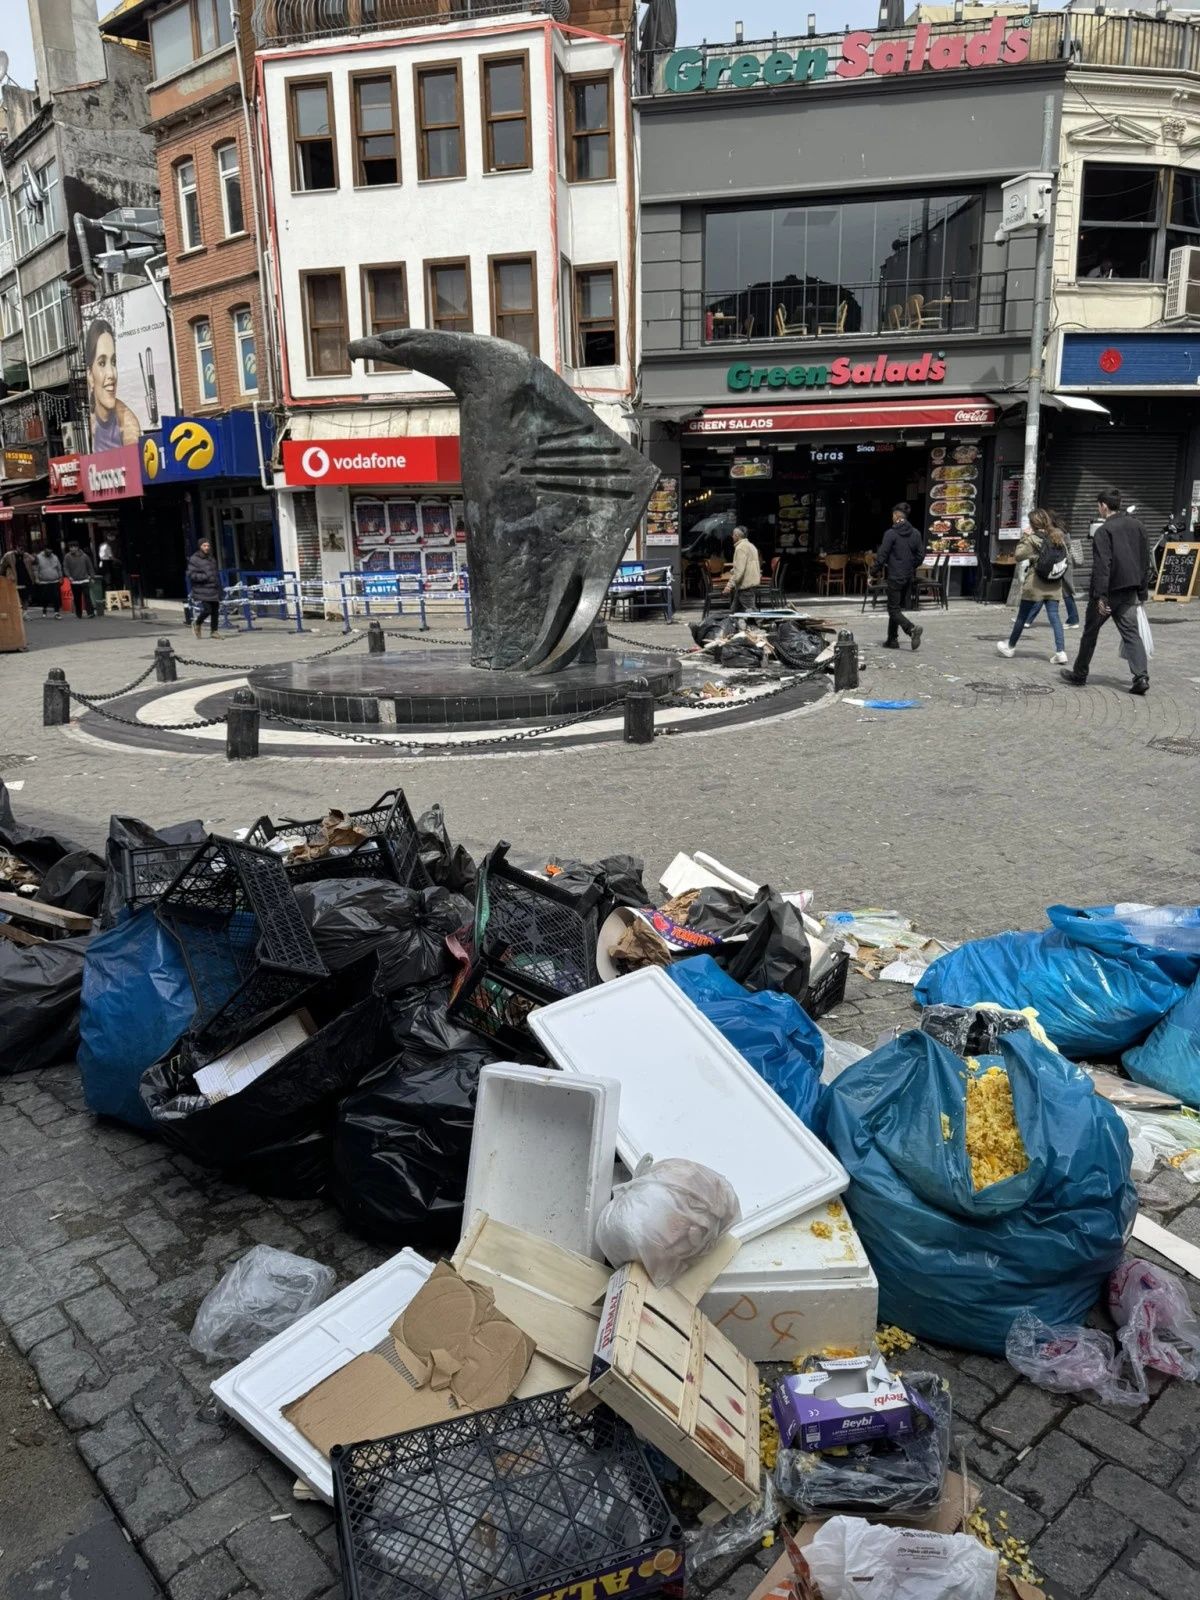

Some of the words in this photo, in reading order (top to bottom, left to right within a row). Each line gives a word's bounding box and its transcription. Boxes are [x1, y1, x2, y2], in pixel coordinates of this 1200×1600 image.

[664, 47, 829, 93] Green
[834, 16, 1032, 79] Salads
[141, 325, 151, 333] YOUR
[151, 321, 166, 331] COLOR
[727, 361, 828, 390] Green
[829, 353, 946, 386] Salads
[689, 420, 727, 431] GREEN
[728, 418, 774, 429] SALADS
[810, 450, 844, 461] Teras
[856, 444, 876, 453] Since
[333, 453, 407, 470] vodafone
[873, 1392, 904, 1407] Beybi
[842, 1415, 873, 1430] Beybi
